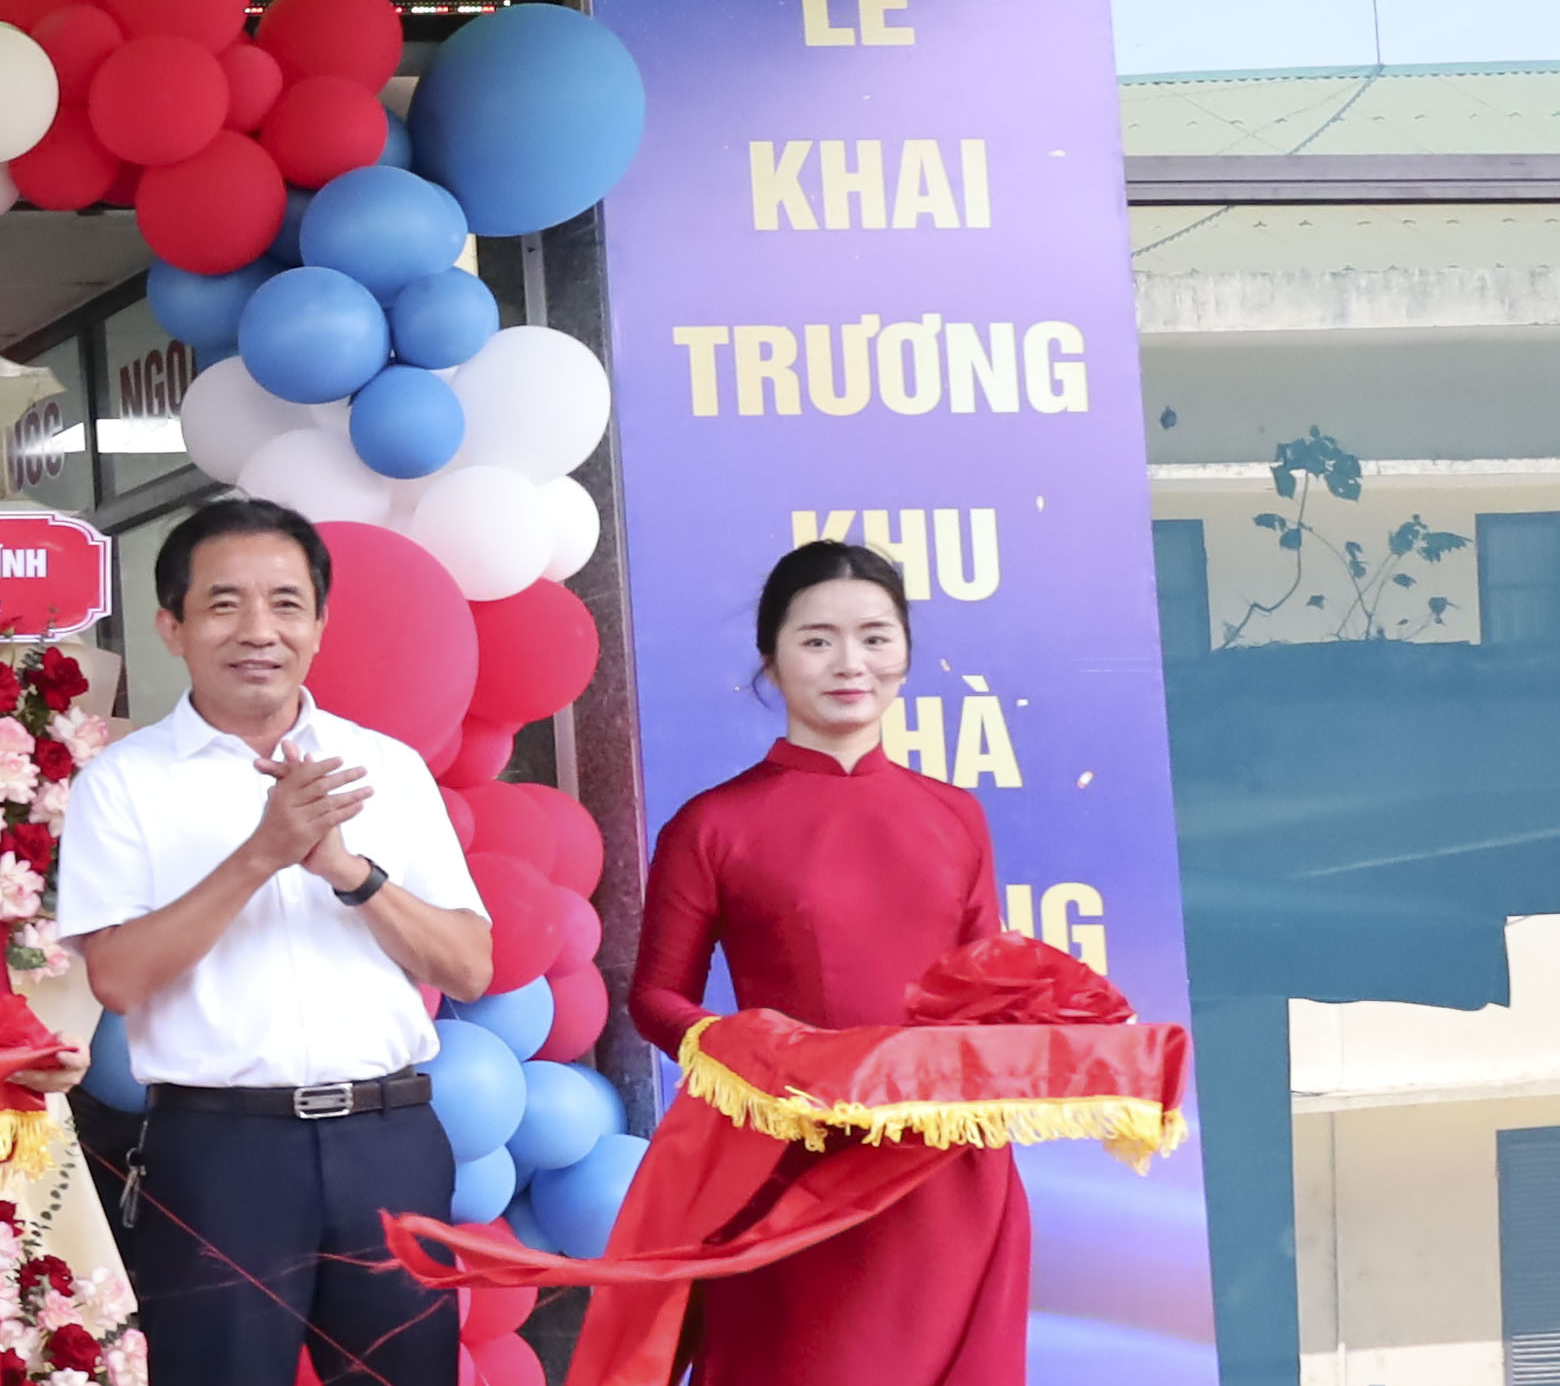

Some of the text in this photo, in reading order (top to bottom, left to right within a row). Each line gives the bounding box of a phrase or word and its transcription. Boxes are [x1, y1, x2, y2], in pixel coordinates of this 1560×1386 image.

[748, 138, 991, 231] KHAI
[120, 338, 198, 418] NGO
[672, 313, 1089, 416] TRƯƠNG
[880, 674, 1023, 789] HÀ
